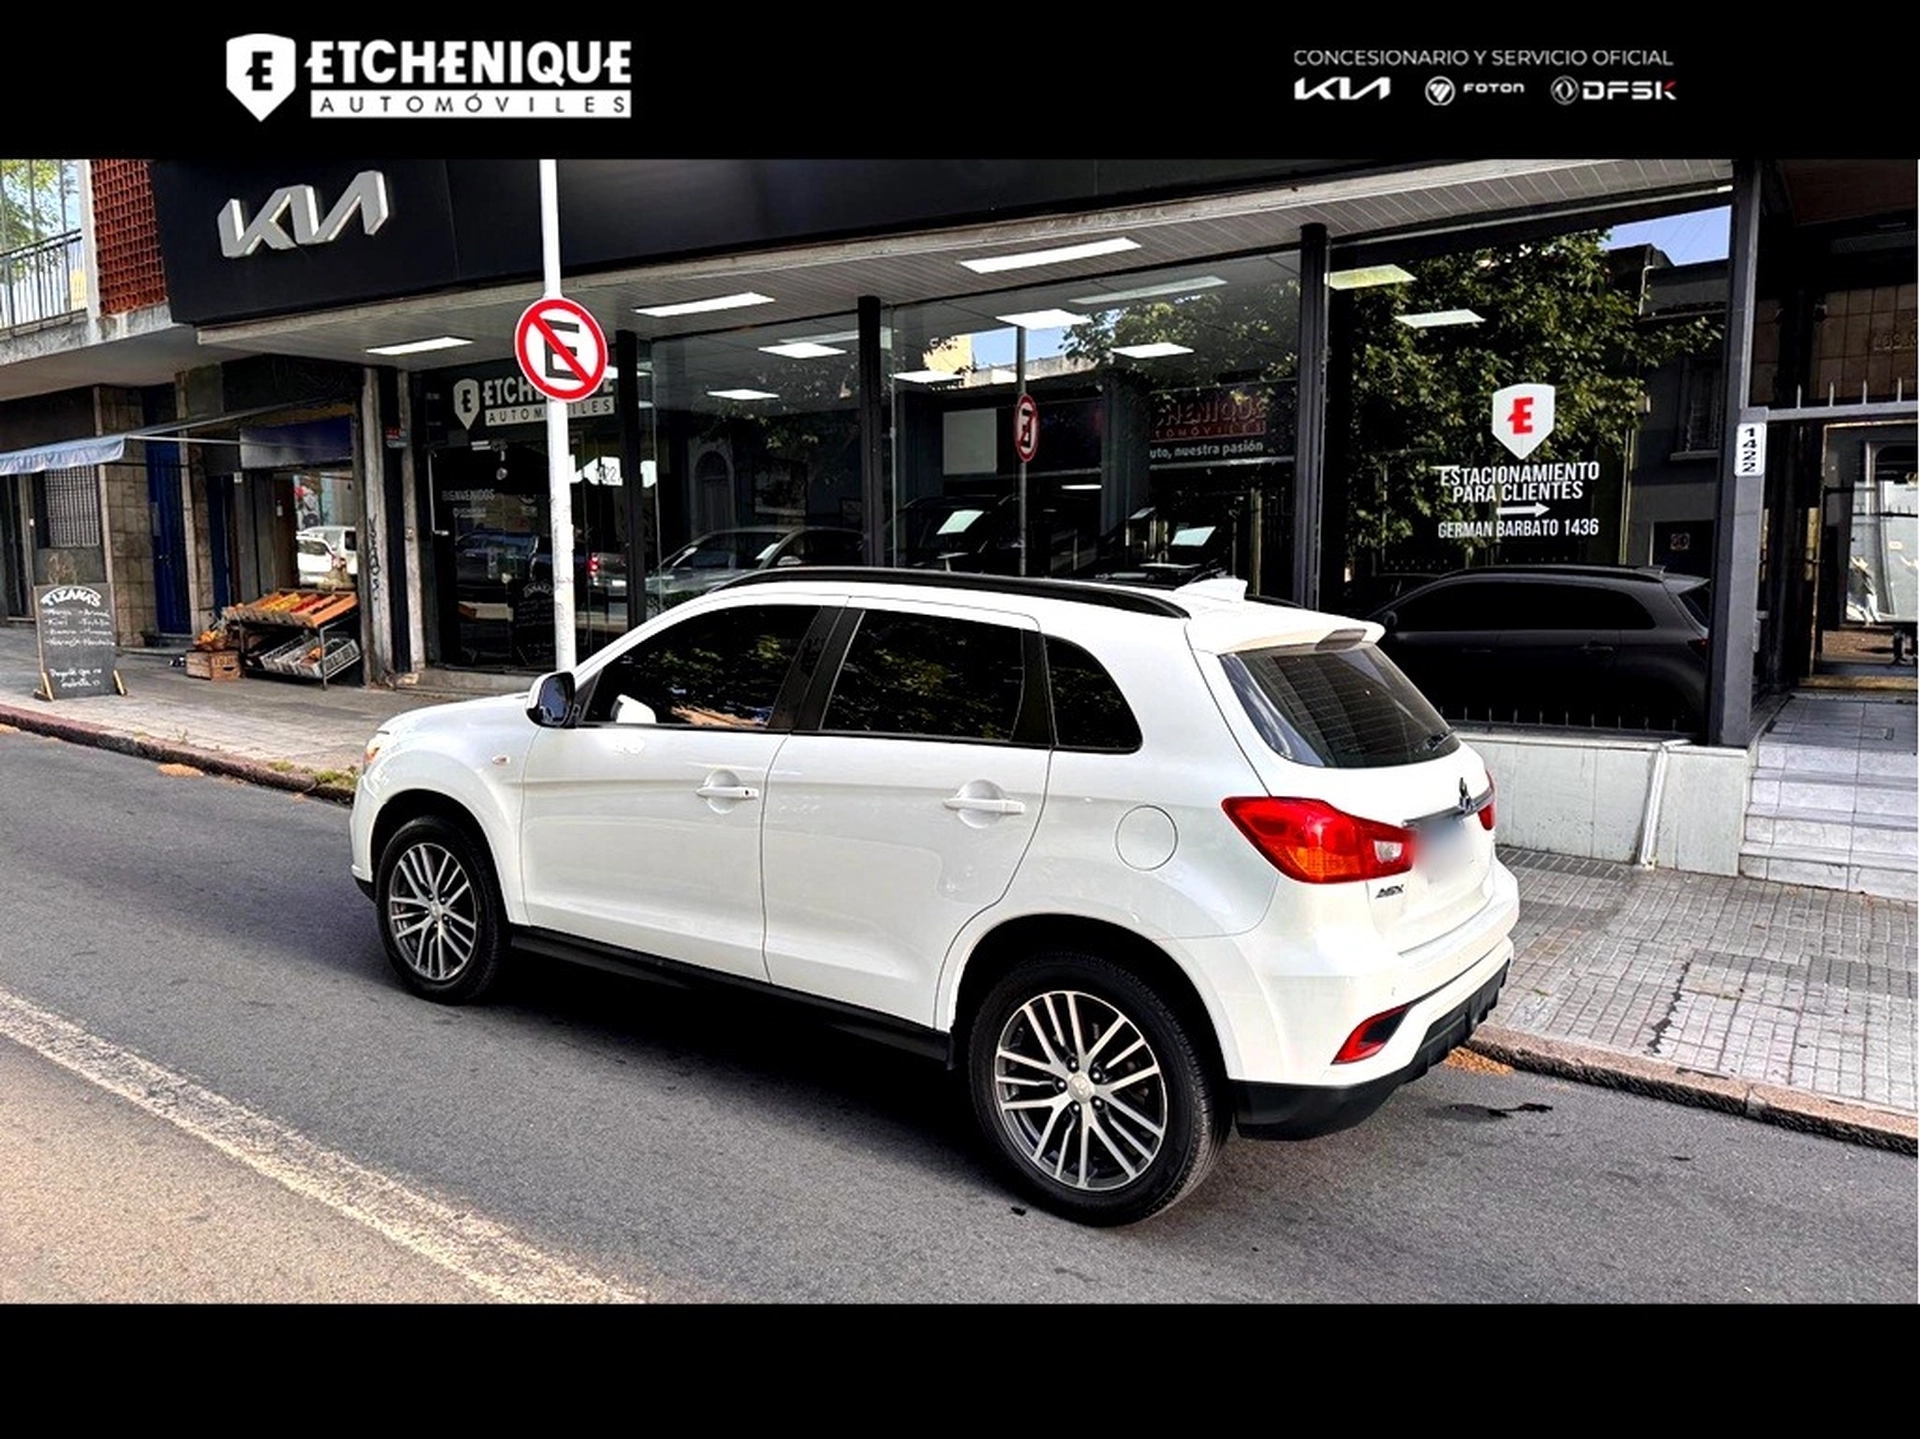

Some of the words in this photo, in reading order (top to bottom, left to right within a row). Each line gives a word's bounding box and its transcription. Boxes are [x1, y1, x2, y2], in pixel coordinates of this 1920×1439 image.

[217, 170, 389, 258] KIA
[1507, 397, 1534, 435] E
[1174, 444, 1219, 457] nuestra
[1223, 440, 1264, 456] pasión
[1742, 427, 1757, 473] 1422
[1440, 461, 1599, 486] ESTACIONAMIENTO
[1453, 485, 1497, 503] PARA
[1501, 481, 1583, 501] CLIENTES
[1438, 521, 1492, 538] GERMAN
[1497, 519, 1558, 536] BARBATO
[1564, 518, 1599, 535] 1436
